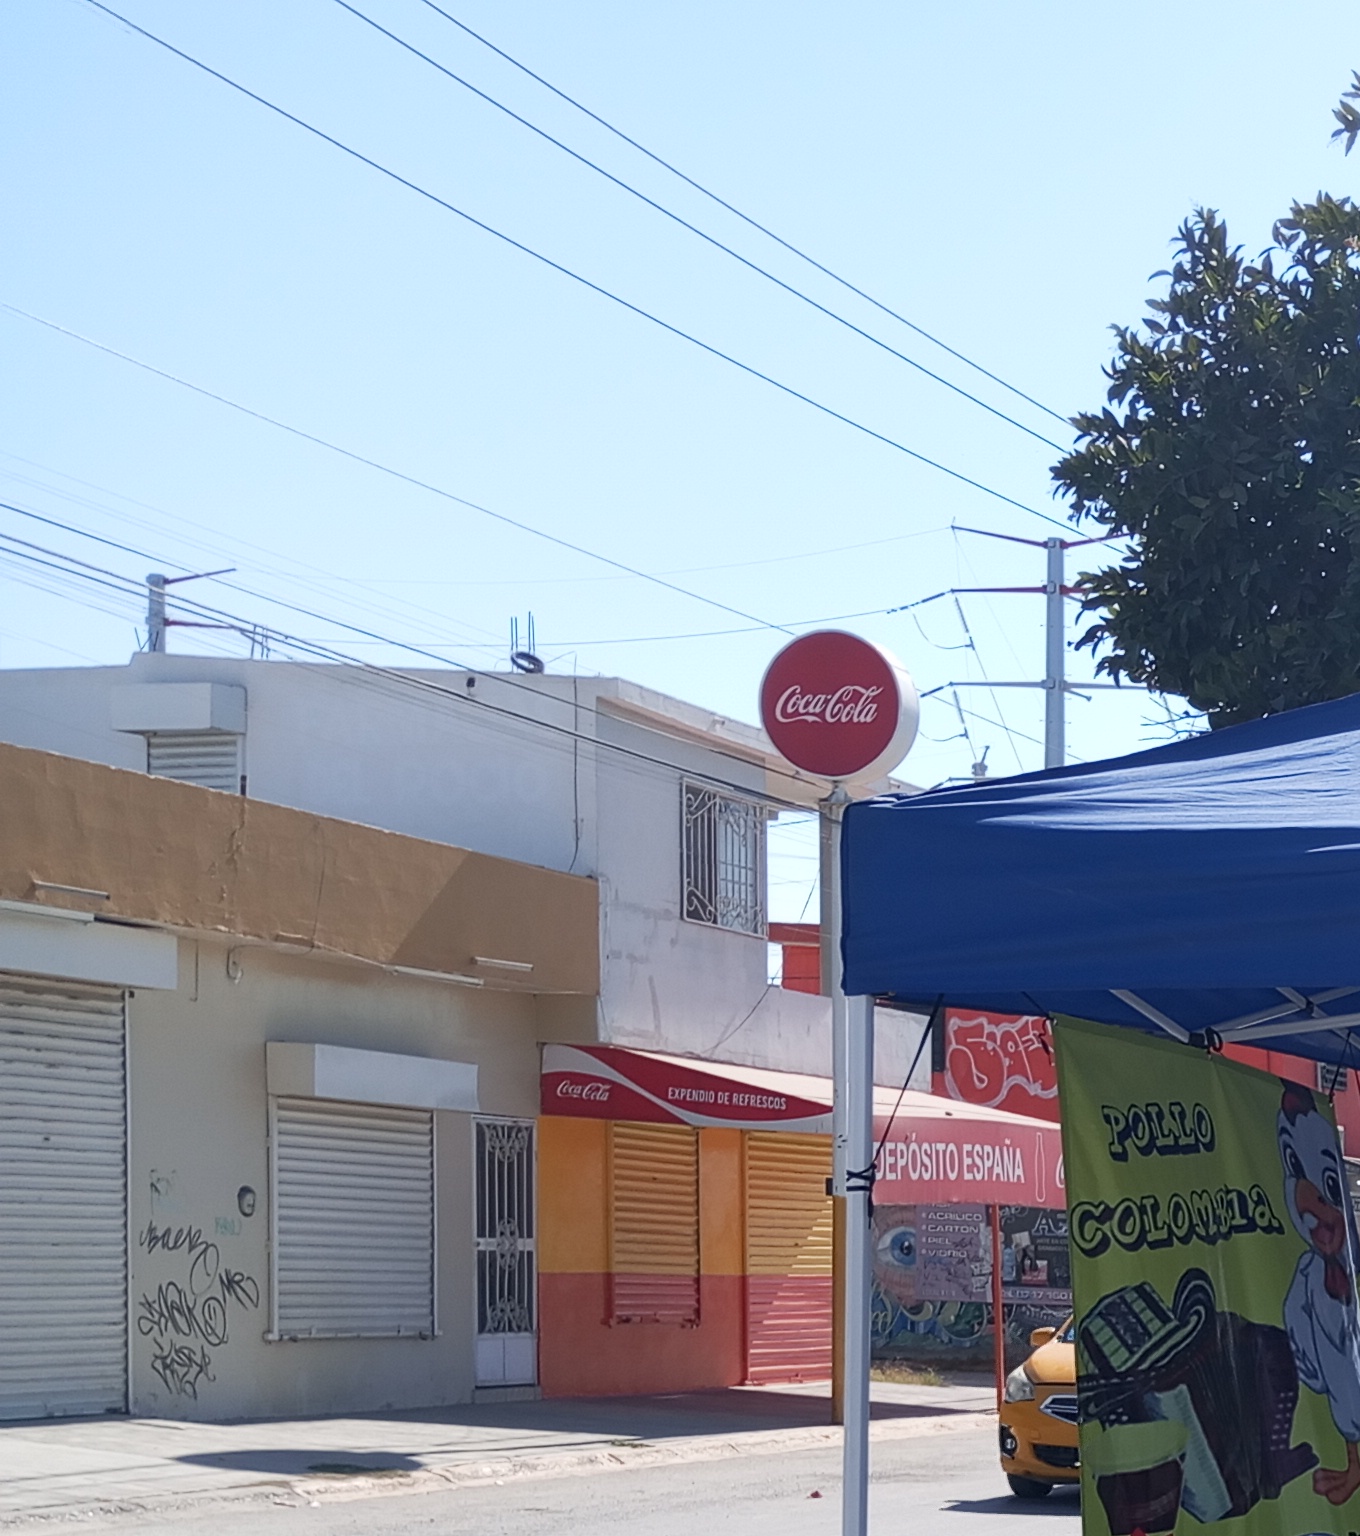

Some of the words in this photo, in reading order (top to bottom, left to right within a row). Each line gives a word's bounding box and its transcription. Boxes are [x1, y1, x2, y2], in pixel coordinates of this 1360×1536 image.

[775, 685, 884, 724] Coca-Cola
[556, 1079, 612, 1101] Coca-Cola
[668, 1087, 715, 1104] EXPENDIO
[717, 1091, 730, 1105] DE
[732, 1094, 787, 1111] REFRESCOS
[1102, 1102, 1215, 1162] POLLO
[873, 1132, 959, 1181] DEPÓSITO
[963, 1138, 1025, 1184] ESPAÑA
[928, 1224, 979, 1233] CARTON
